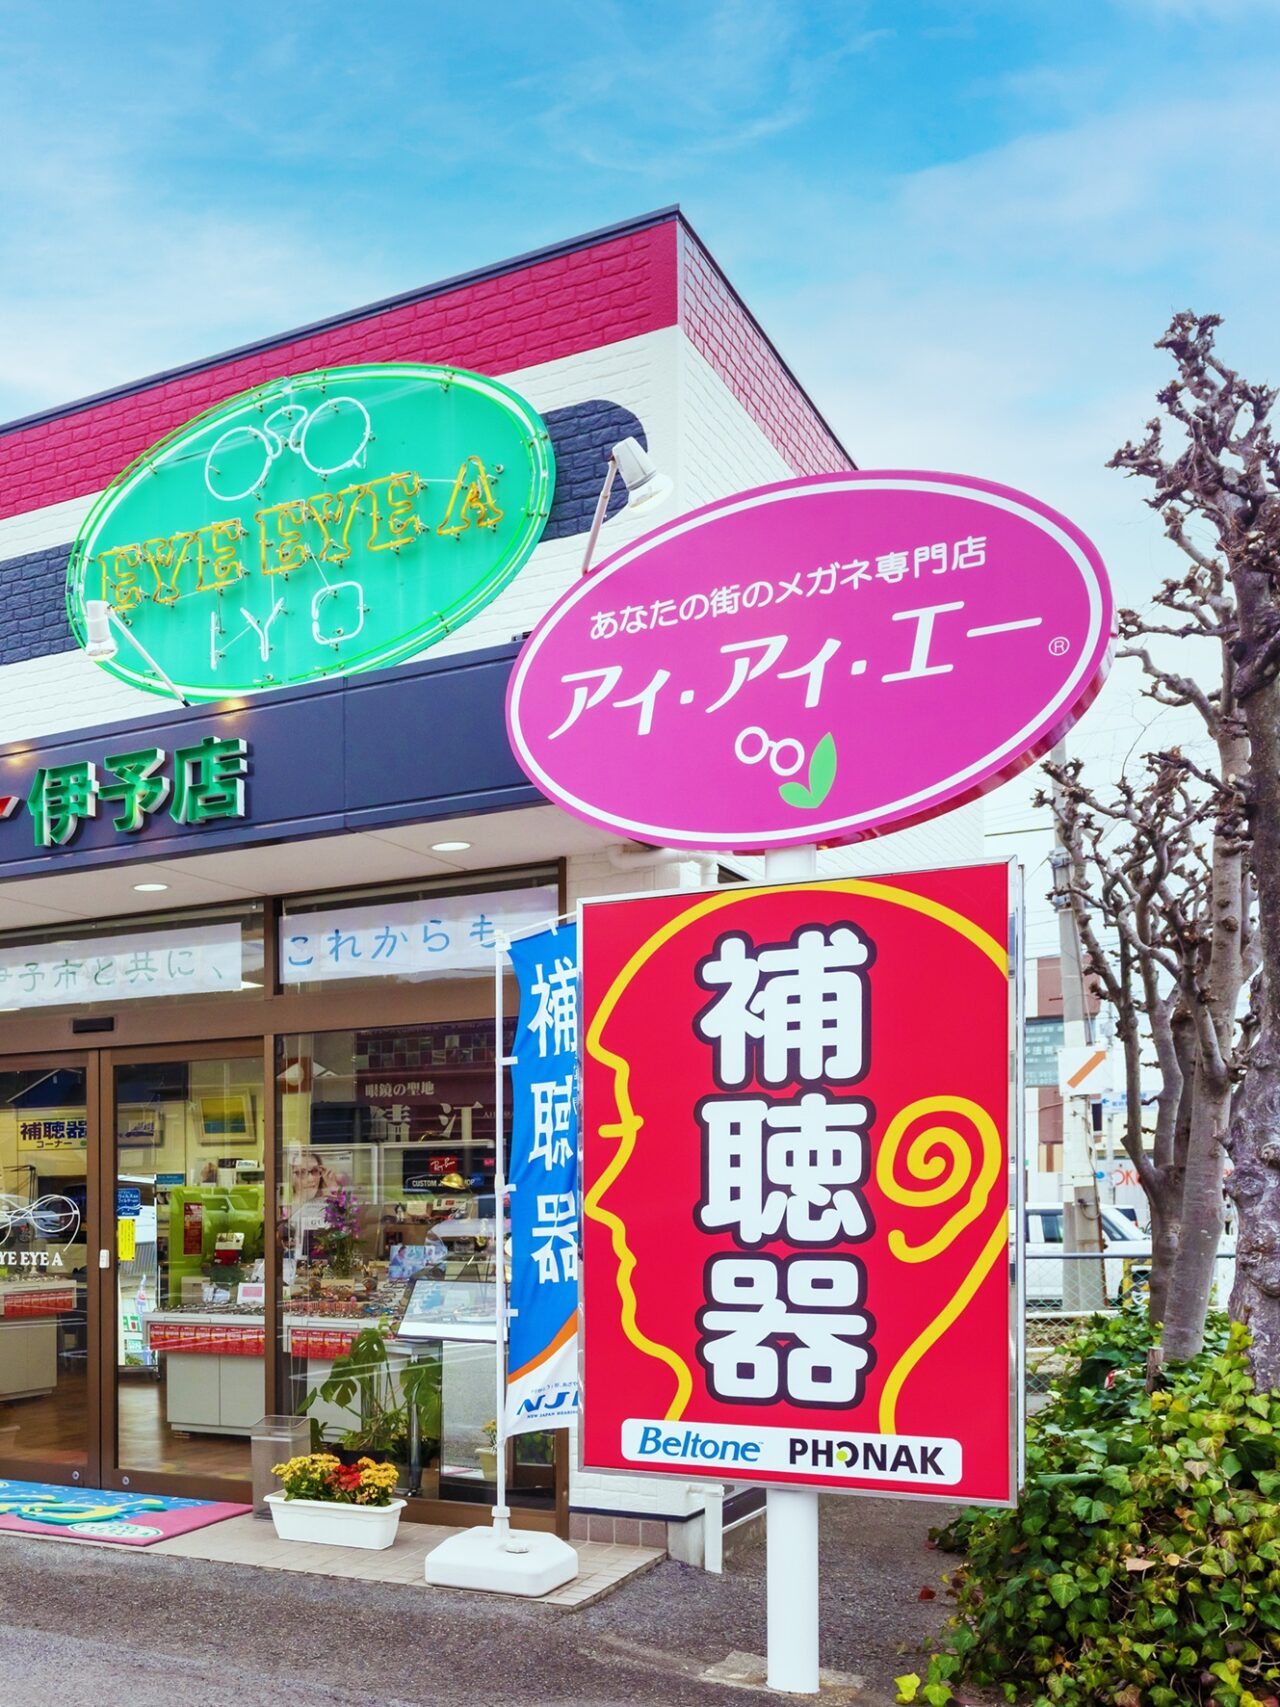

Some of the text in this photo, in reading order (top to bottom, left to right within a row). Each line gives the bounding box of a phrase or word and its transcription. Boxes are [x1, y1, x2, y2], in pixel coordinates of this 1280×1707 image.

[98, 455, 504, 611] EYE EYE A
[589, 535, 988, 640] あなたの街のメガネ専門店
[211, 580, 365, 671] IYO
[26, 736, 248, 847] 伊予店
[287, 913, 497, 967] これからも
[364, 1081, 435, 1098] 眼鏡の聖地
[20, 1120, 87, 1141] 補聴器
[36, 1140, 73, 1149] コーナー
[527, 956, 578, 1284] 補聴器
[412, 1180, 438, 1188] CUSTOM
[697, 924, 873, 1405] 補聴器
[20, 1251, 50, 1266] EYE
[51, 1252, 64, 1267] A
[637, 1426, 946, 1476] Beltone PHONAK
